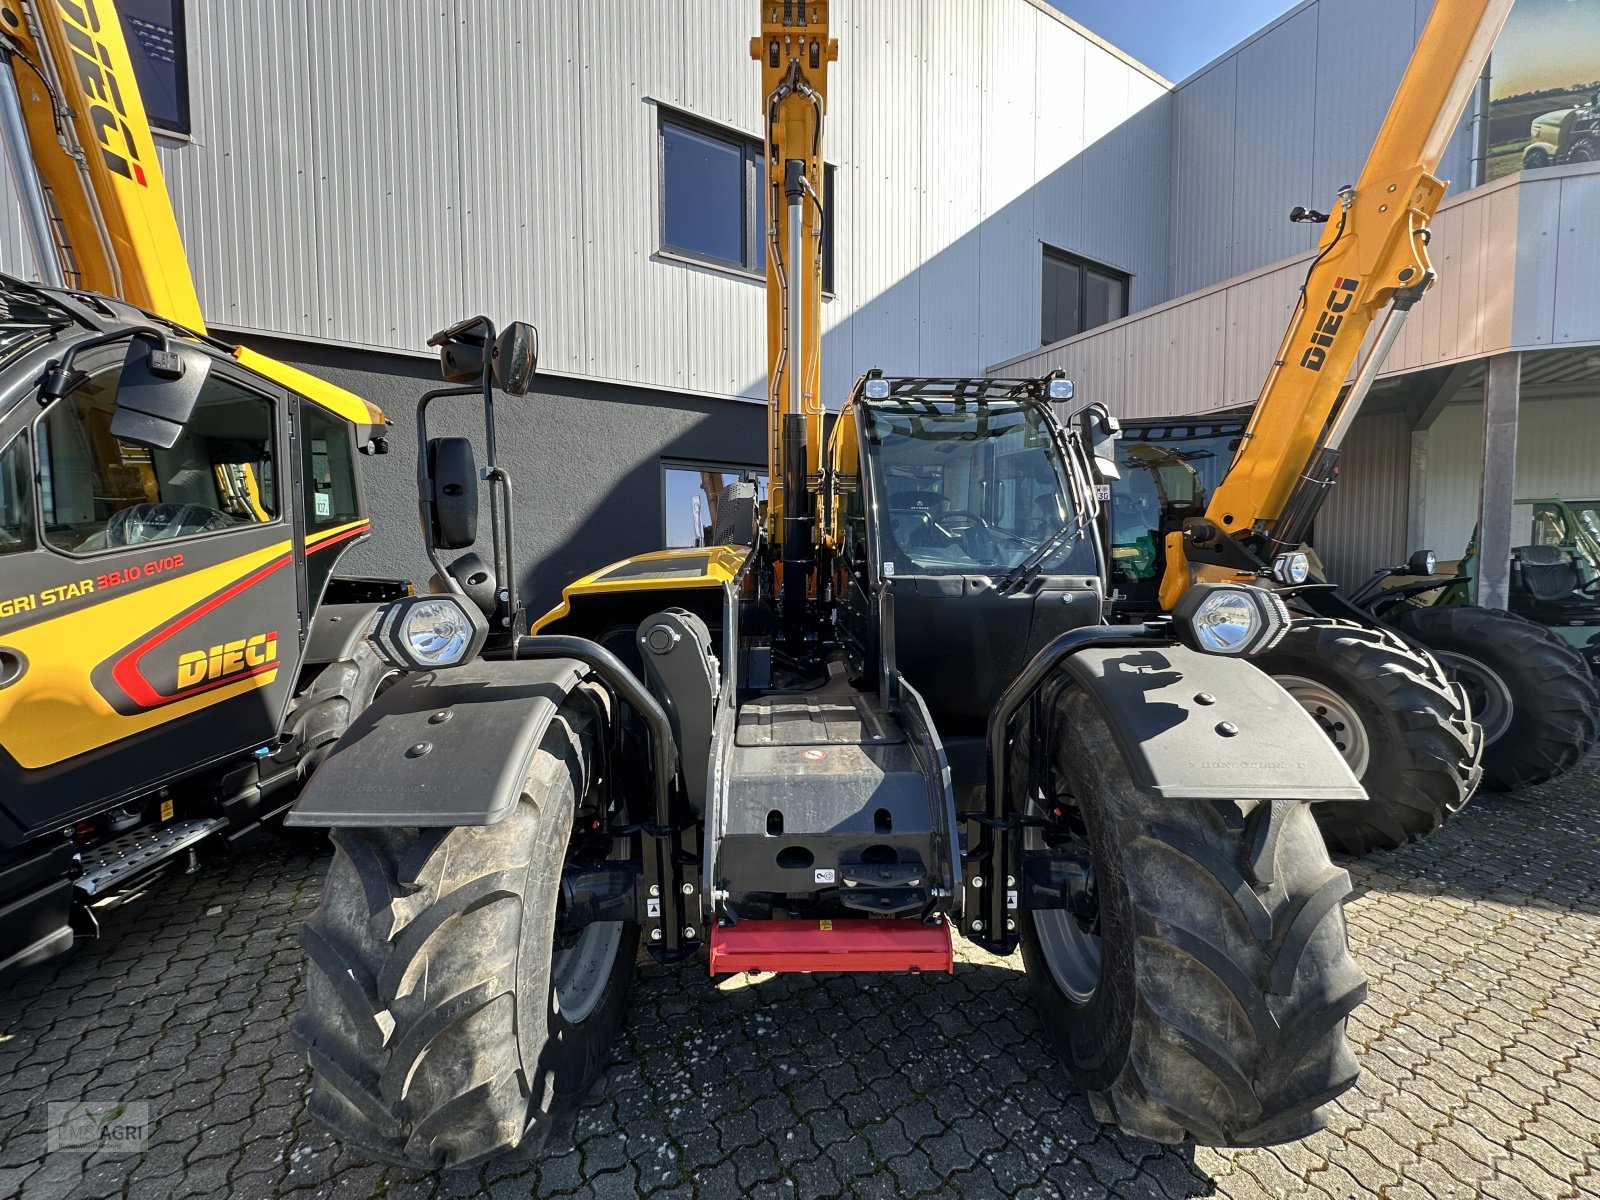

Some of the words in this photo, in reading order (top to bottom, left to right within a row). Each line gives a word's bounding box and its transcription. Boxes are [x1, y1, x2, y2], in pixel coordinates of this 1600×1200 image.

[1300, 276, 1359, 372] DIECI
[0, 594, 36, 618] GRI
[40, 579, 94, 606] STAR
[97, 566, 141, 590] 38.10
[177, 631, 277, 689] DIECI
